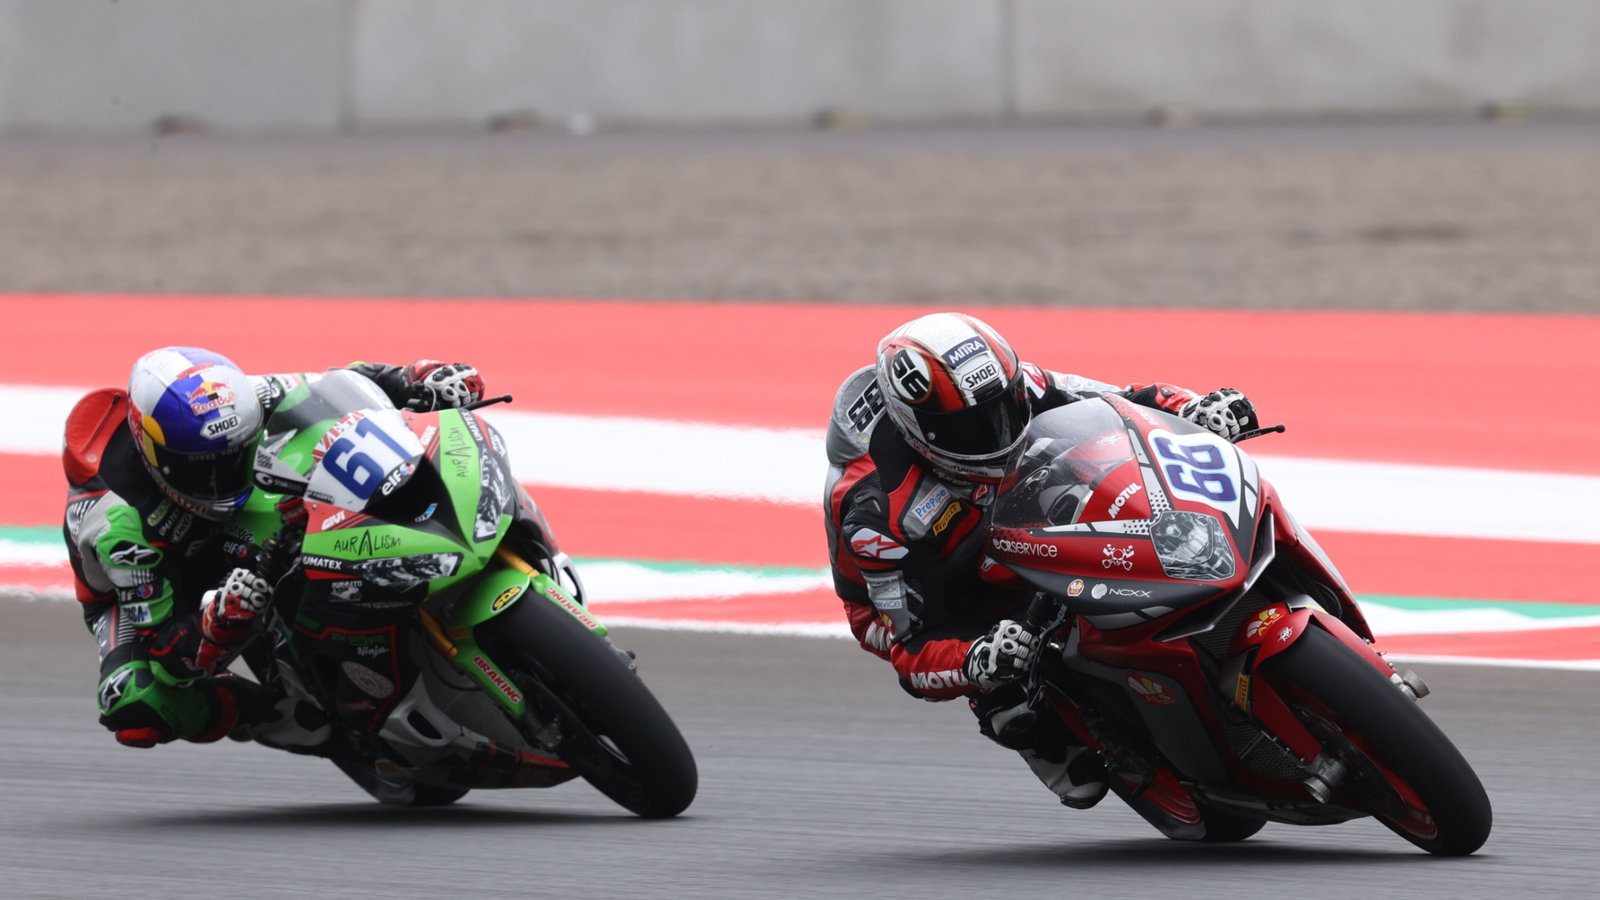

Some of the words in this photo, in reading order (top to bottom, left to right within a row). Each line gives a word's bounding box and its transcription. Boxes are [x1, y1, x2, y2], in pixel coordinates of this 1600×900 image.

[950, 339, 985, 365] MITRA
[892, 348, 930, 400] 56
[965, 364, 997, 389] SHOEI
[191, 400, 217, 417] Red
[217, 391, 235, 407] Bull
[207, 416, 238, 436] SHOEI
[322, 417, 413, 500] 61
[1153, 436, 1238, 503] 66
[381, 470, 402, 496] elf
[915, 487, 949, 518] PrePipe
[1107, 483, 1142, 519] MOTUL
[321, 510, 347, 531] GIVI
[333, 529, 401, 556] AURALISM
[302, 555, 342, 570] UMATEX
[1108, 587, 1152, 598] NCXX
[357, 645, 390, 659] Ninja
[472, 656, 523, 703] BRAKING
[910, 669, 970, 690] MOTU
